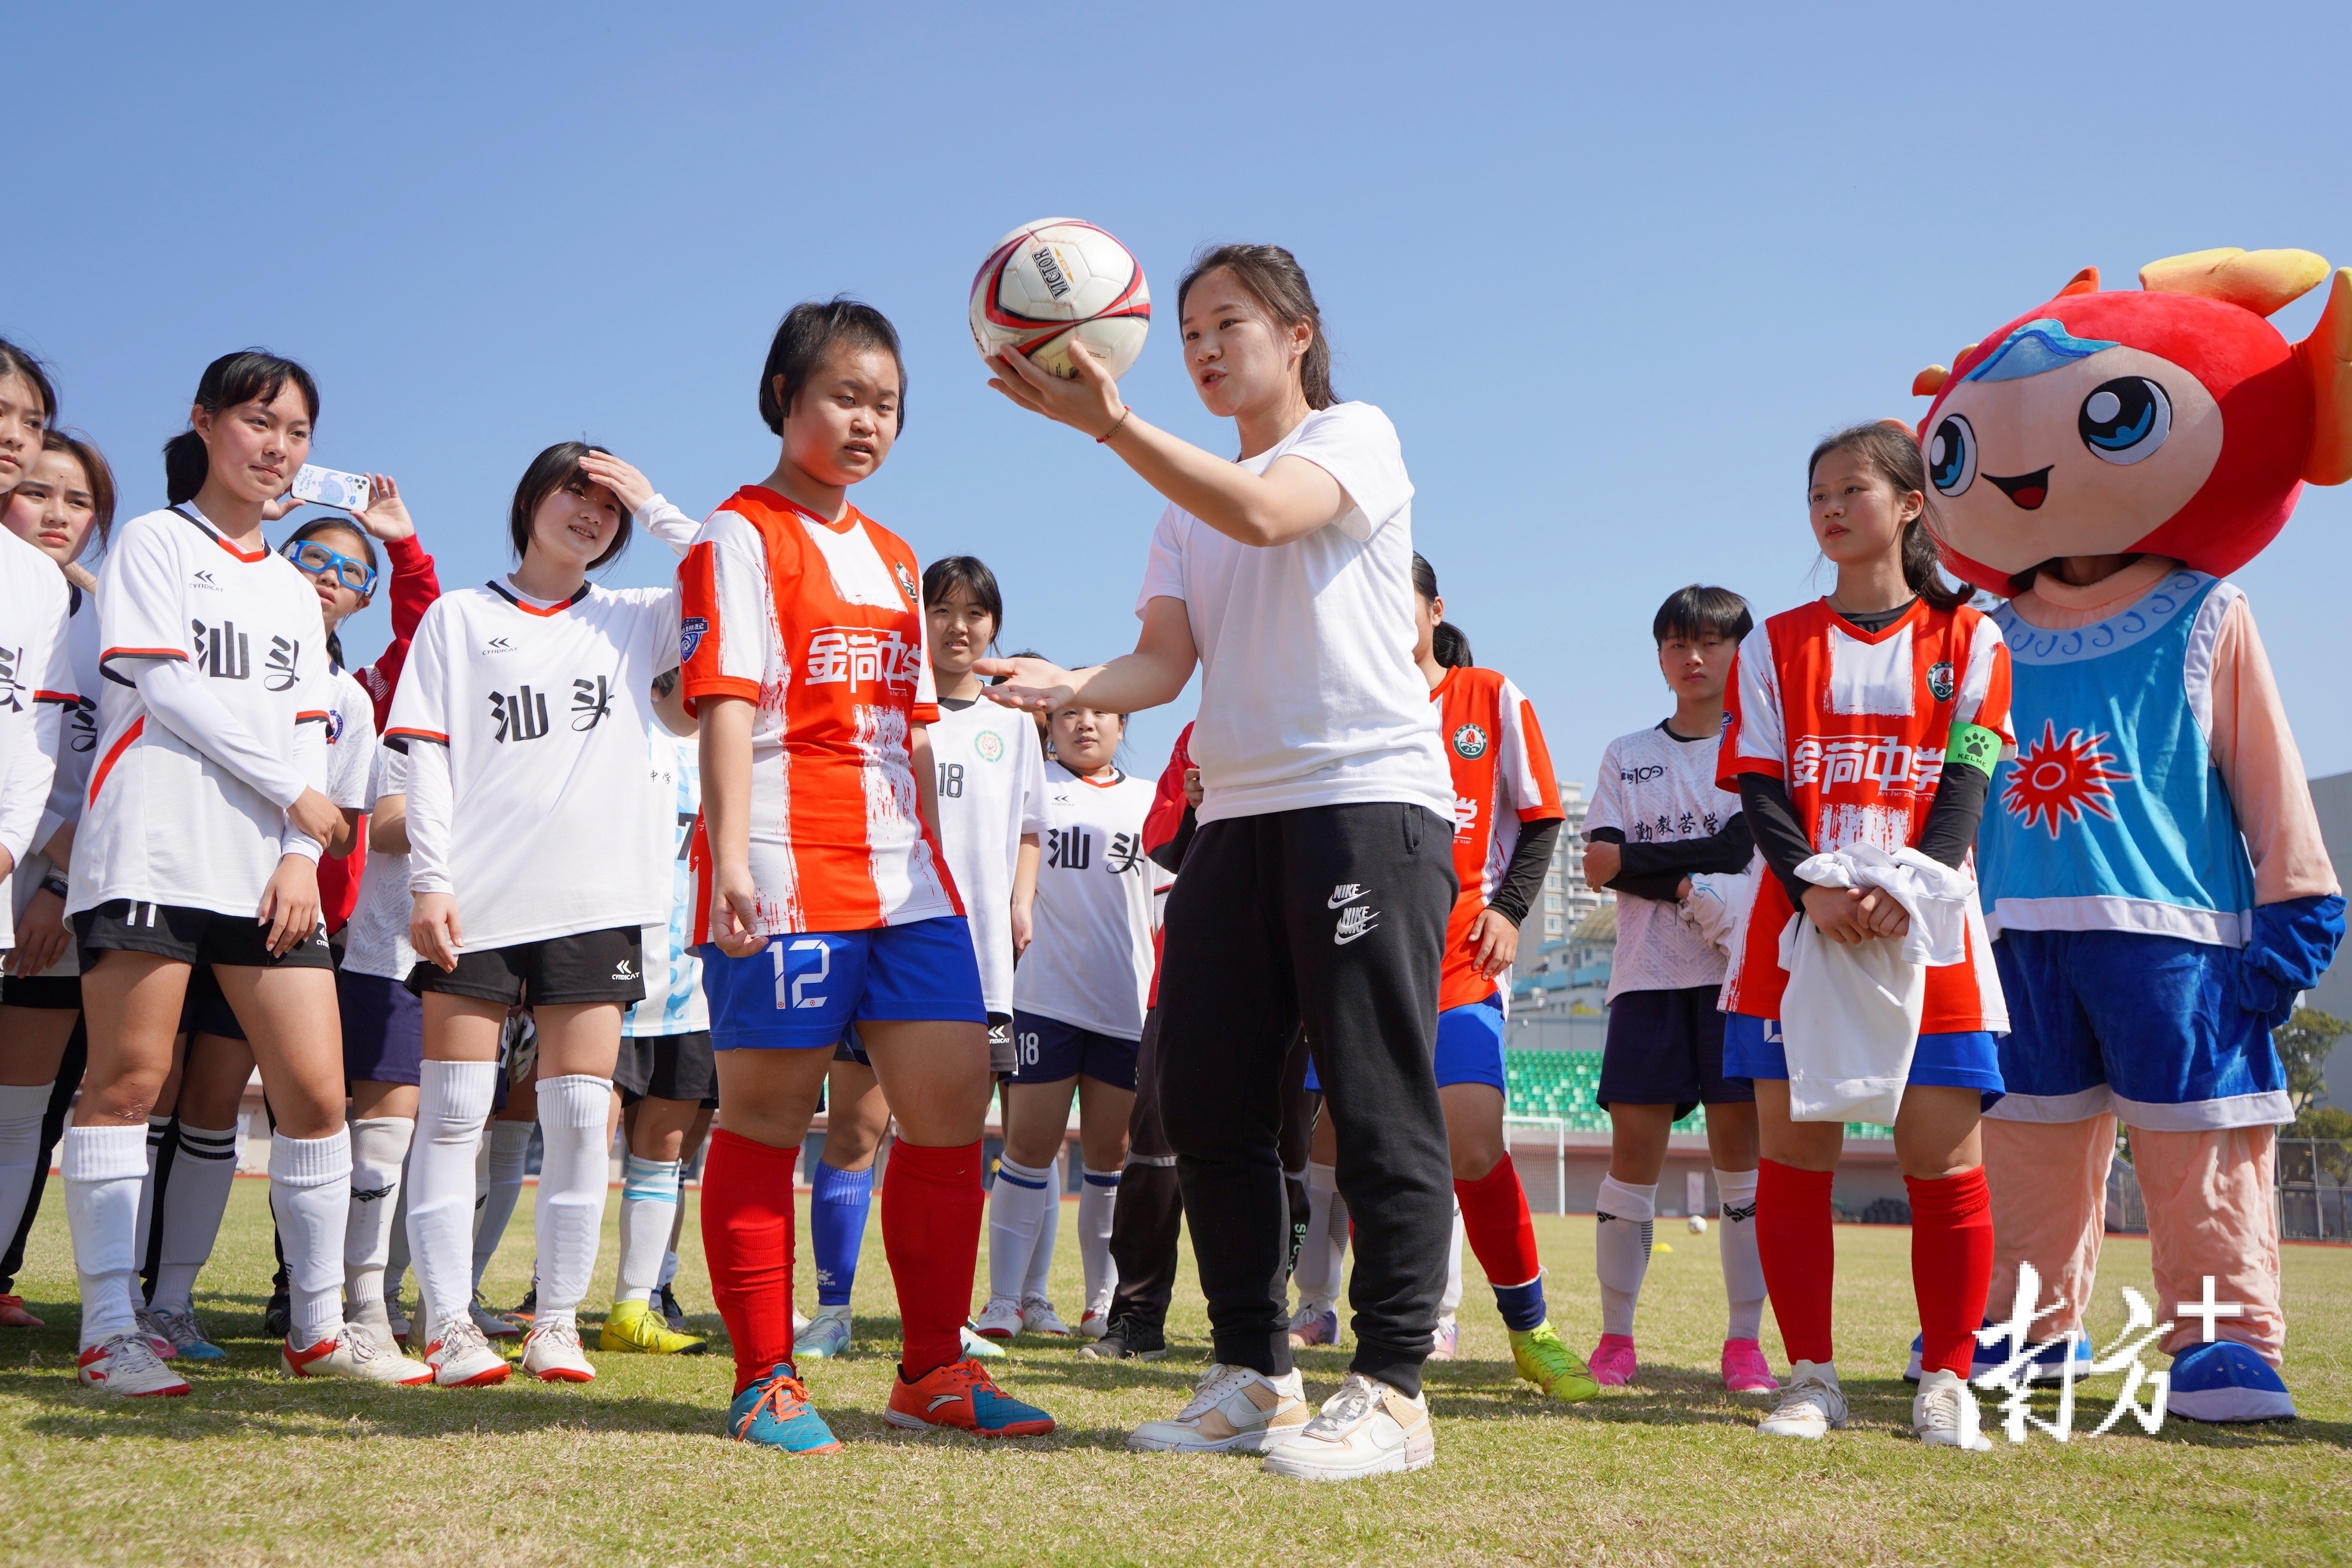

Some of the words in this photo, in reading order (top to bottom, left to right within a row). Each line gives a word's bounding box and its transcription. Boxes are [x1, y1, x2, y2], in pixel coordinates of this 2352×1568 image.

[1032, 246, 1070, 300] VICTOR
[189, 583, 224, 593] CYNDICAT
[191, 618, 301, 692] 汕头
[482, 647, 518, 656] CYNDICAT
[488, 675, 615, 744] 汕头
[1793, 736, 1947, 795] 金荷中学
[1957, 753, 1986, 768] KELME
[650, 770, 671, 785] 中学
[938, 762, 964, 798] 18
[1048, 826, 1144, 877] 汕头
[1333, 883, 1361, 899] NIKE
[1342, 906, 1370, 927] NIKE
[611, 972, 640, 981] CYNDICAT
[765, 939, 830, 1010] 12
[1018, 1032, 1039, 1065] 18
